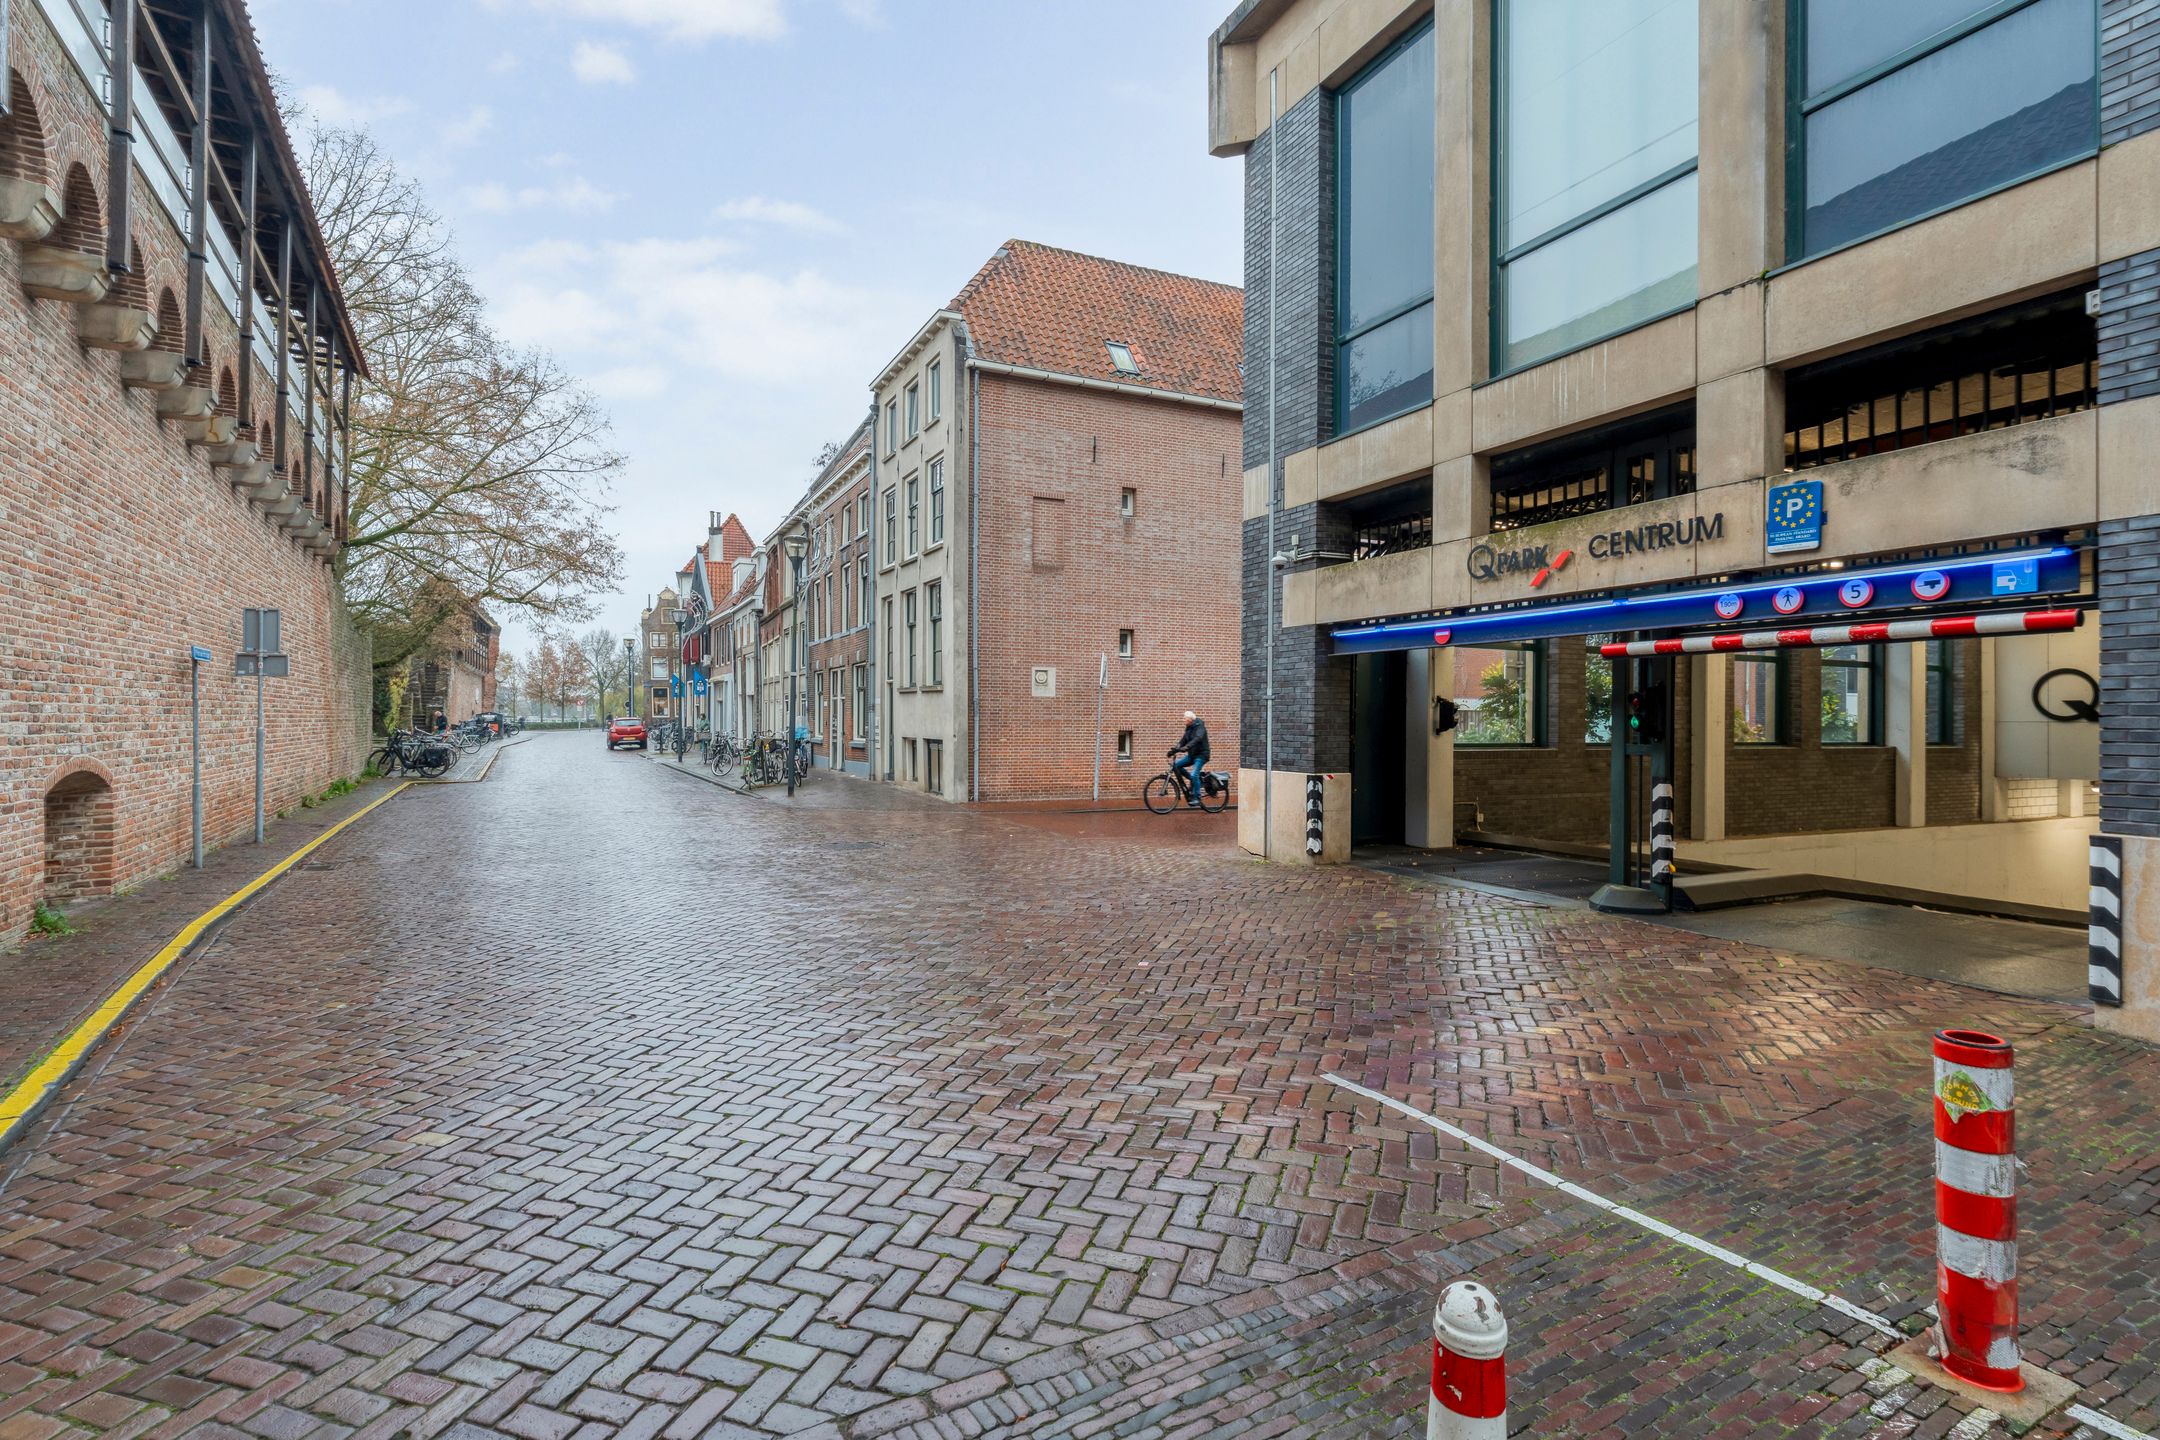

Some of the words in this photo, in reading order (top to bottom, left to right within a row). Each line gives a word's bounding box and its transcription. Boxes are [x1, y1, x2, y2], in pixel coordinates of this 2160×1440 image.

[1787, 498, 1803, 518] P
[1589, 512, 1724, 558] CENTRUM
[1851, 584, 1861, 599] 5
[2032, 668, 2099, 723] Q
